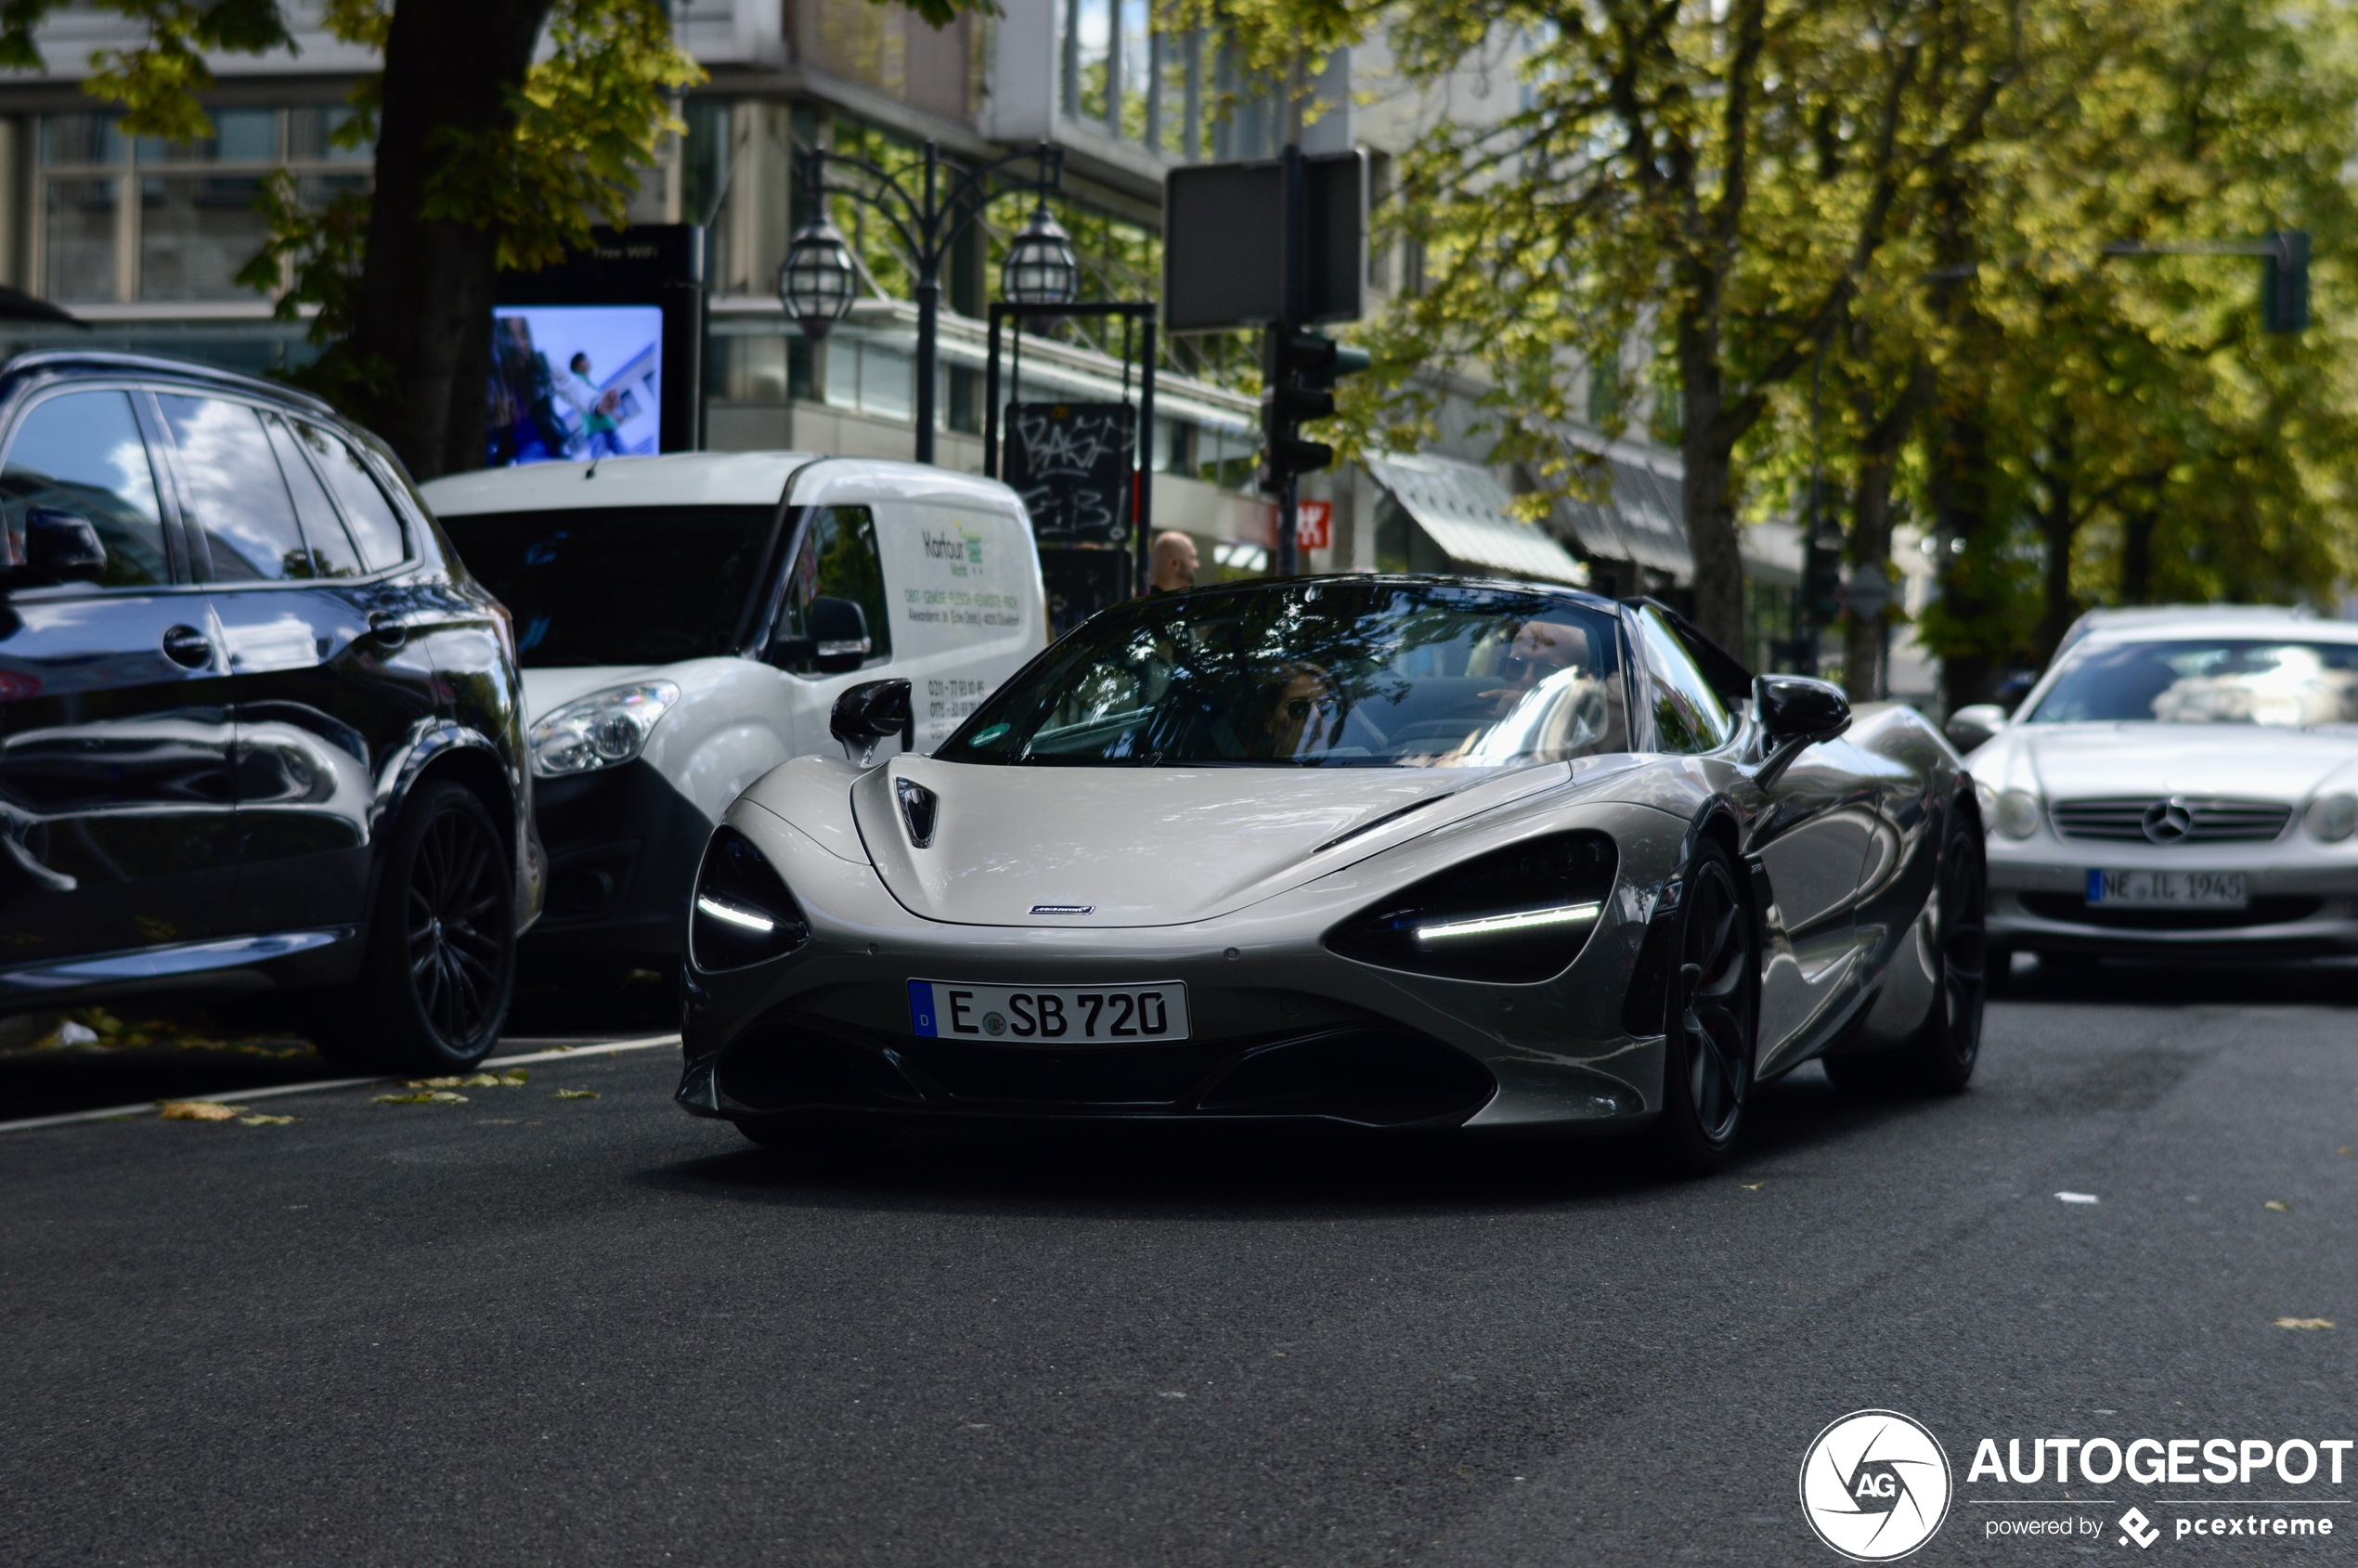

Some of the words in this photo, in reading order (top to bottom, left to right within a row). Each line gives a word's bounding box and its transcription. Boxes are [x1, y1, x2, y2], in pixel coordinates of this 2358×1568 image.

[904, 589, 920, 603] OBST
[924, 588, 947, 604] GEMÜSE
[949, 591, 971, 606] FLEISCH
[928, 680, 944, 696] 0211
[930, 702, 945, 718] 0176
[2103, 873, 2130, 899] NE
[2151, 873, 2175, 899] IL
[2186, 873, 2243, 899] 1945
[920, 1014, 928, 1026] D
[949, 990, 979, 1034] E
[1009, 993, 1068, 1037] SB
[1077, 991, 1167, 1037] 720
